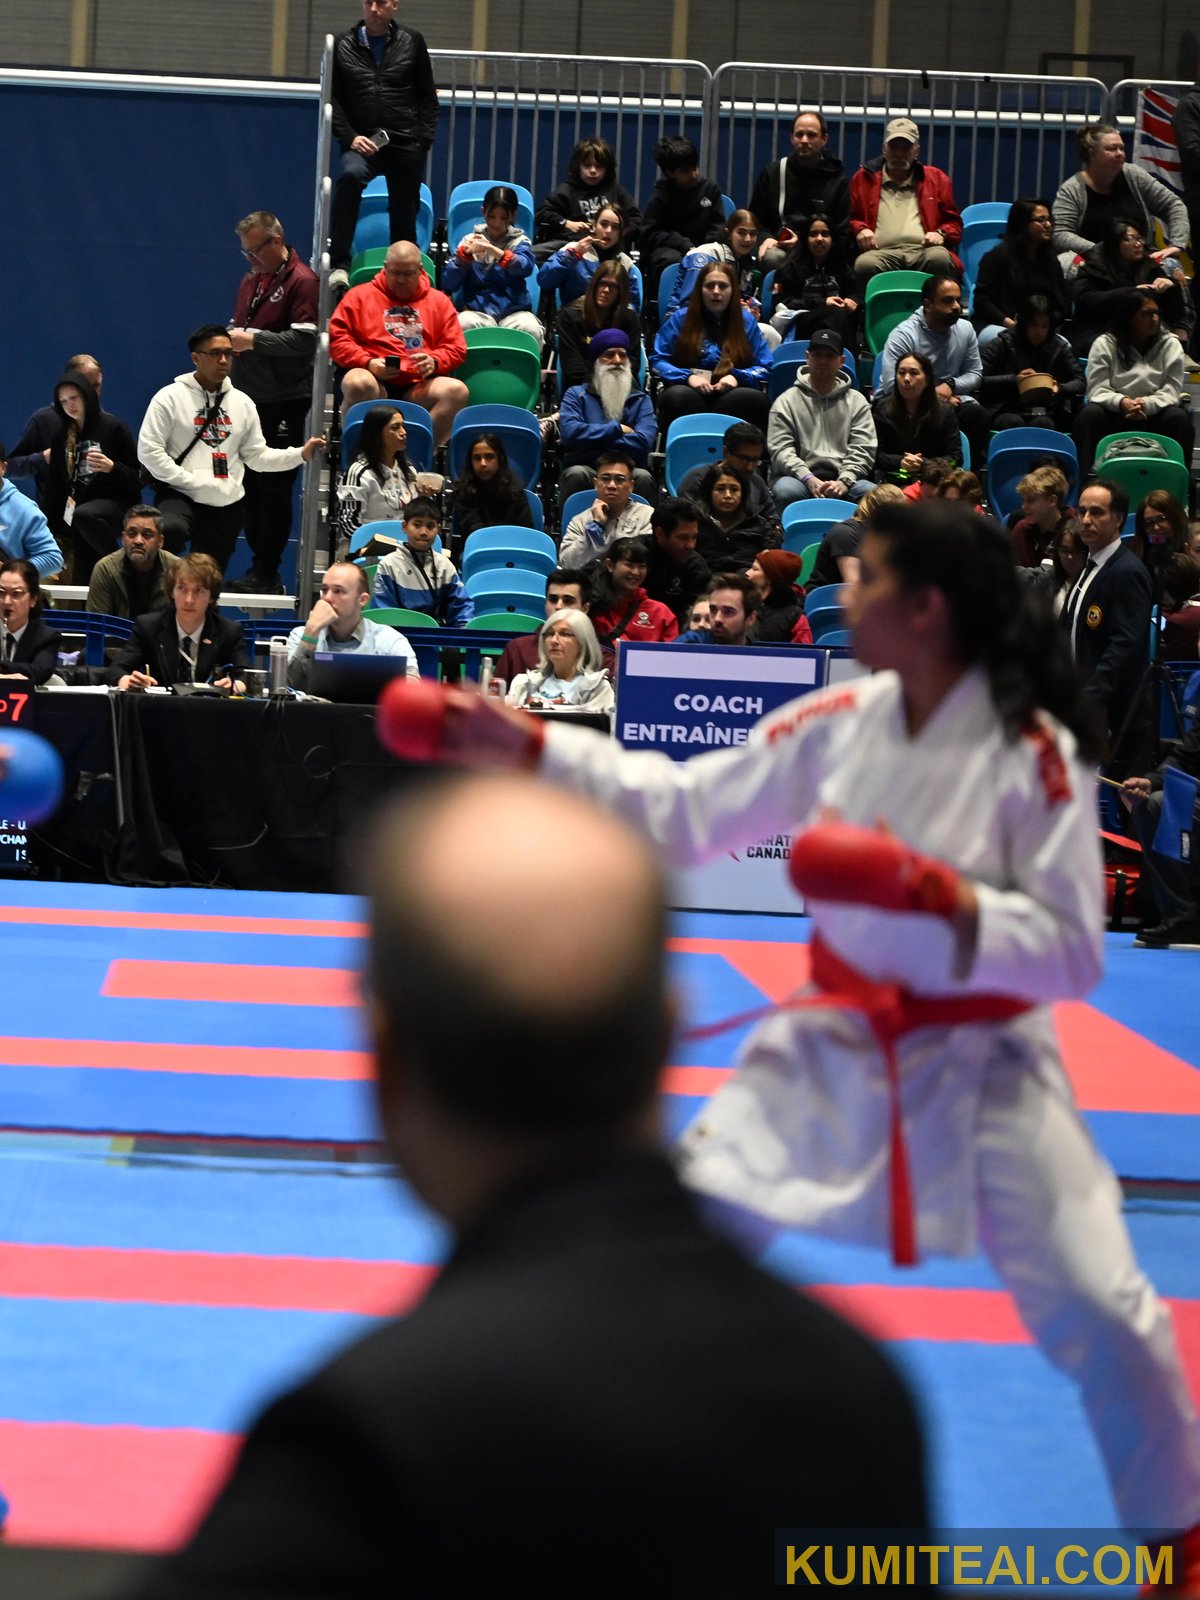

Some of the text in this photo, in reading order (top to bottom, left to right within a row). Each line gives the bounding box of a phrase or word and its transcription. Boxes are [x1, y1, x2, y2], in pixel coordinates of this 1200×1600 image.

[674, 694, 763, 715] COACH
[752, 834, 791, 847] RAT
[746, 846, 791, 860] CANAD
